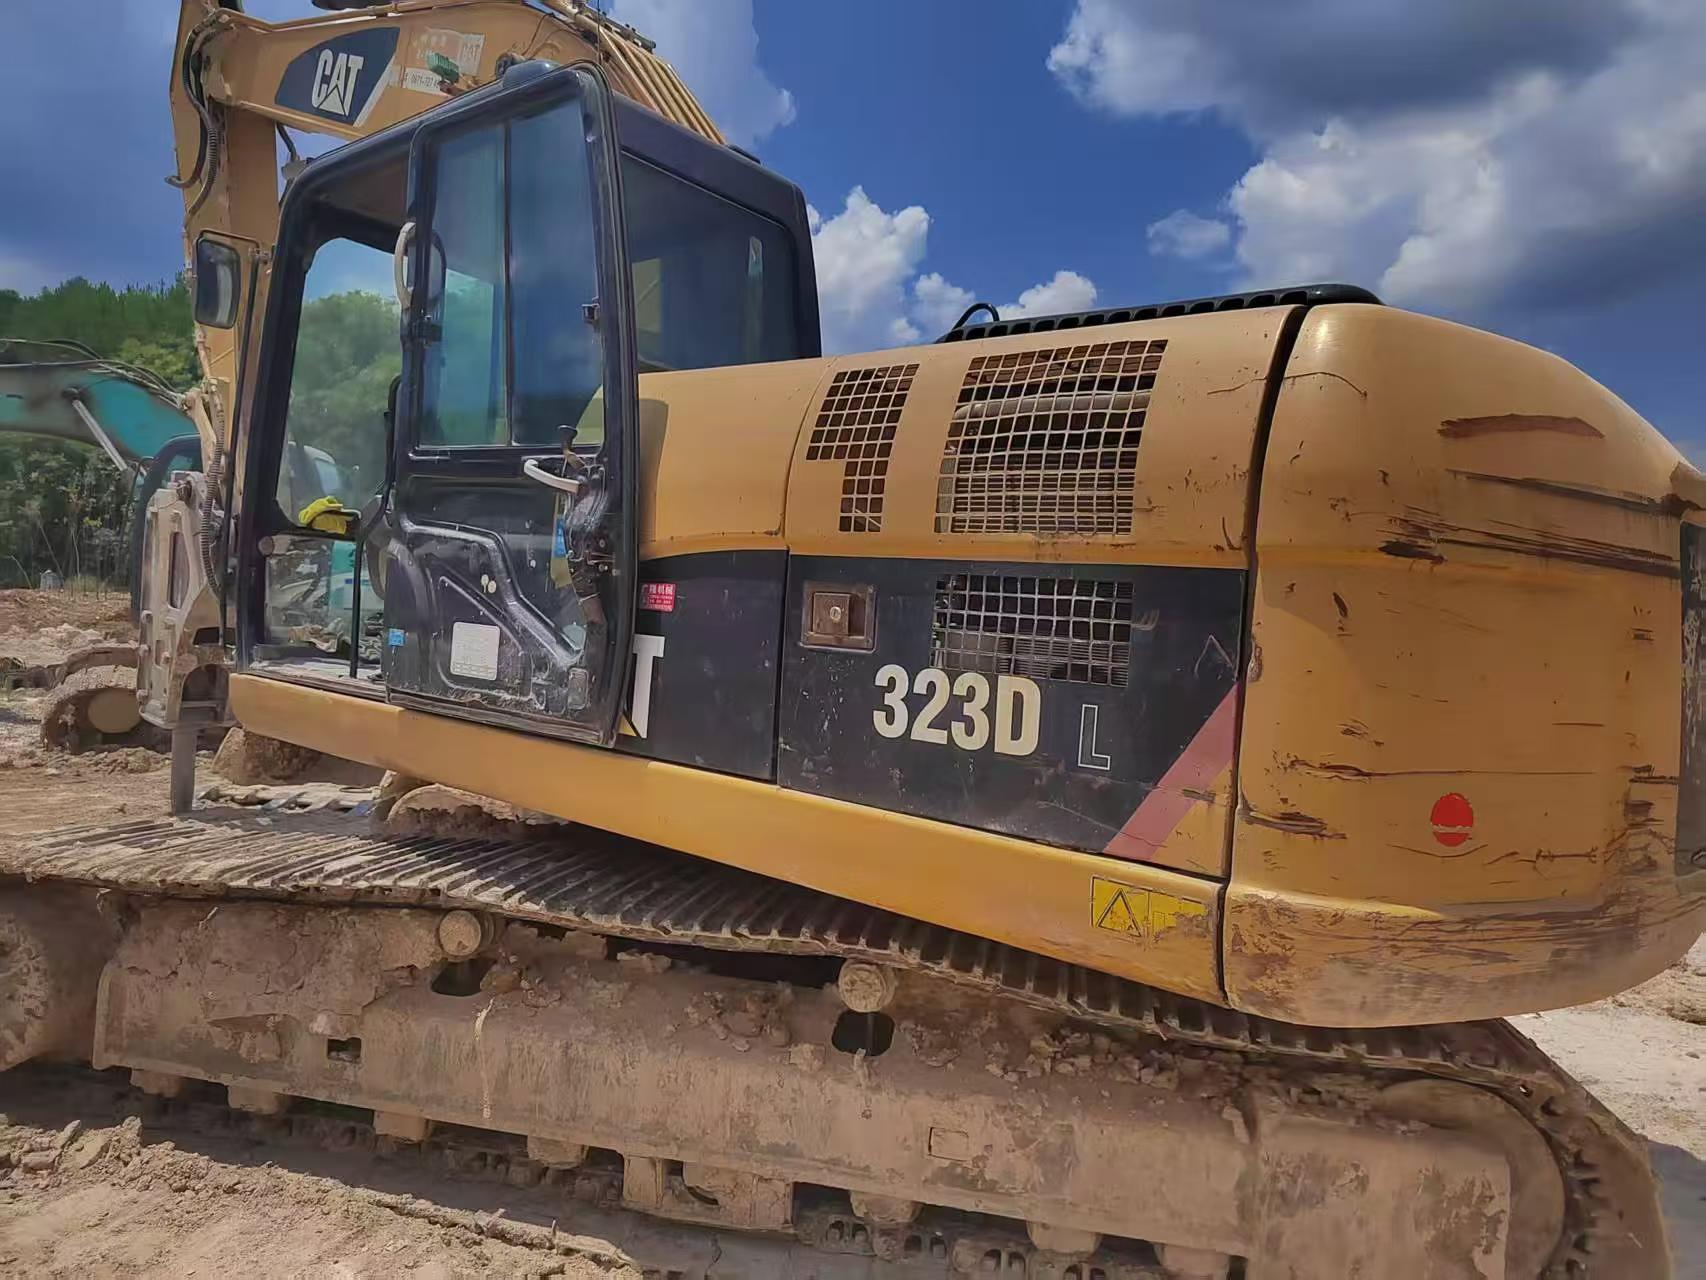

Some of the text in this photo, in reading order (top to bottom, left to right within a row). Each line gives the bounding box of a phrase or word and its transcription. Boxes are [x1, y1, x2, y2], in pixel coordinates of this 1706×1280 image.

[312, 49, 364, 117] CAT
[621, 634, 665, 738] T
[873, 664, 1111, 771] 323D L
